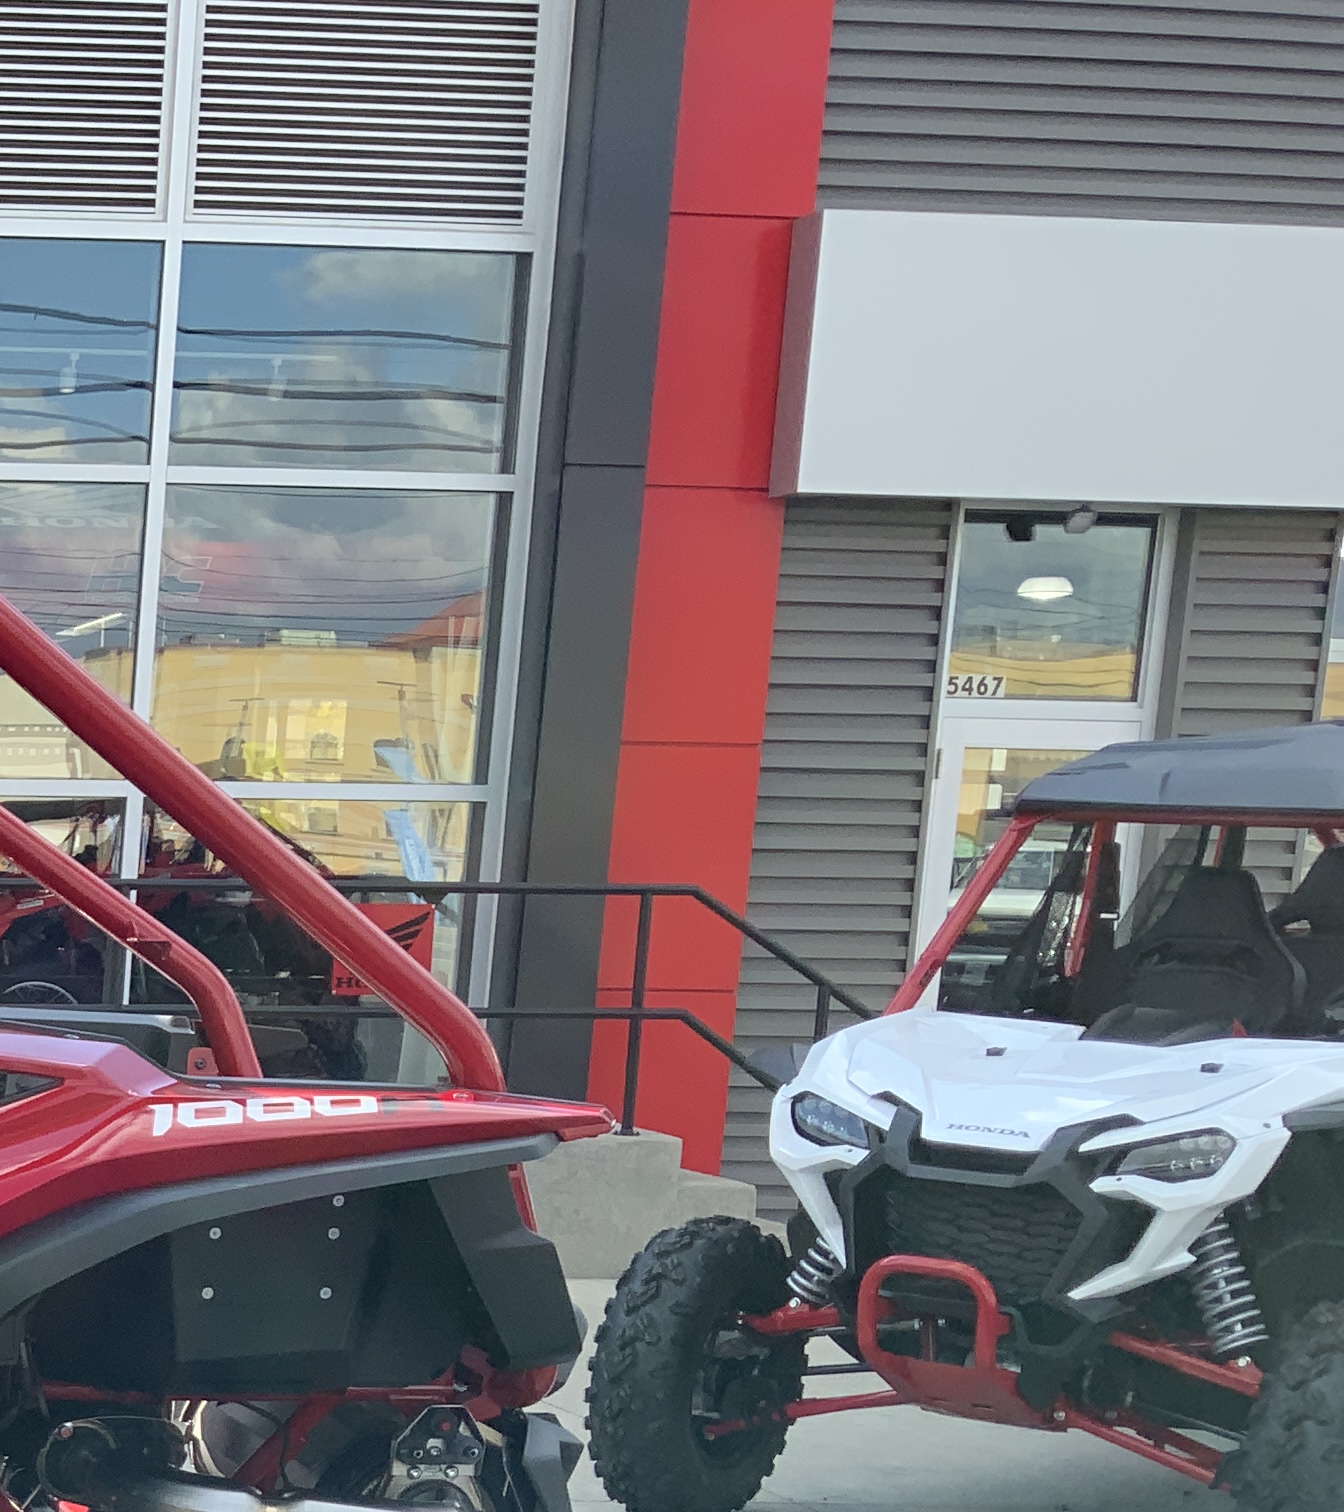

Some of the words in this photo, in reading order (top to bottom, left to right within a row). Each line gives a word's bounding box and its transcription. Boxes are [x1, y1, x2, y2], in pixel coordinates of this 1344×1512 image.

[0, 515, 221, 529] HONA
[946, 675, 1005, 697] 5467
[945, 1123, 1031, 1139] HONDA
